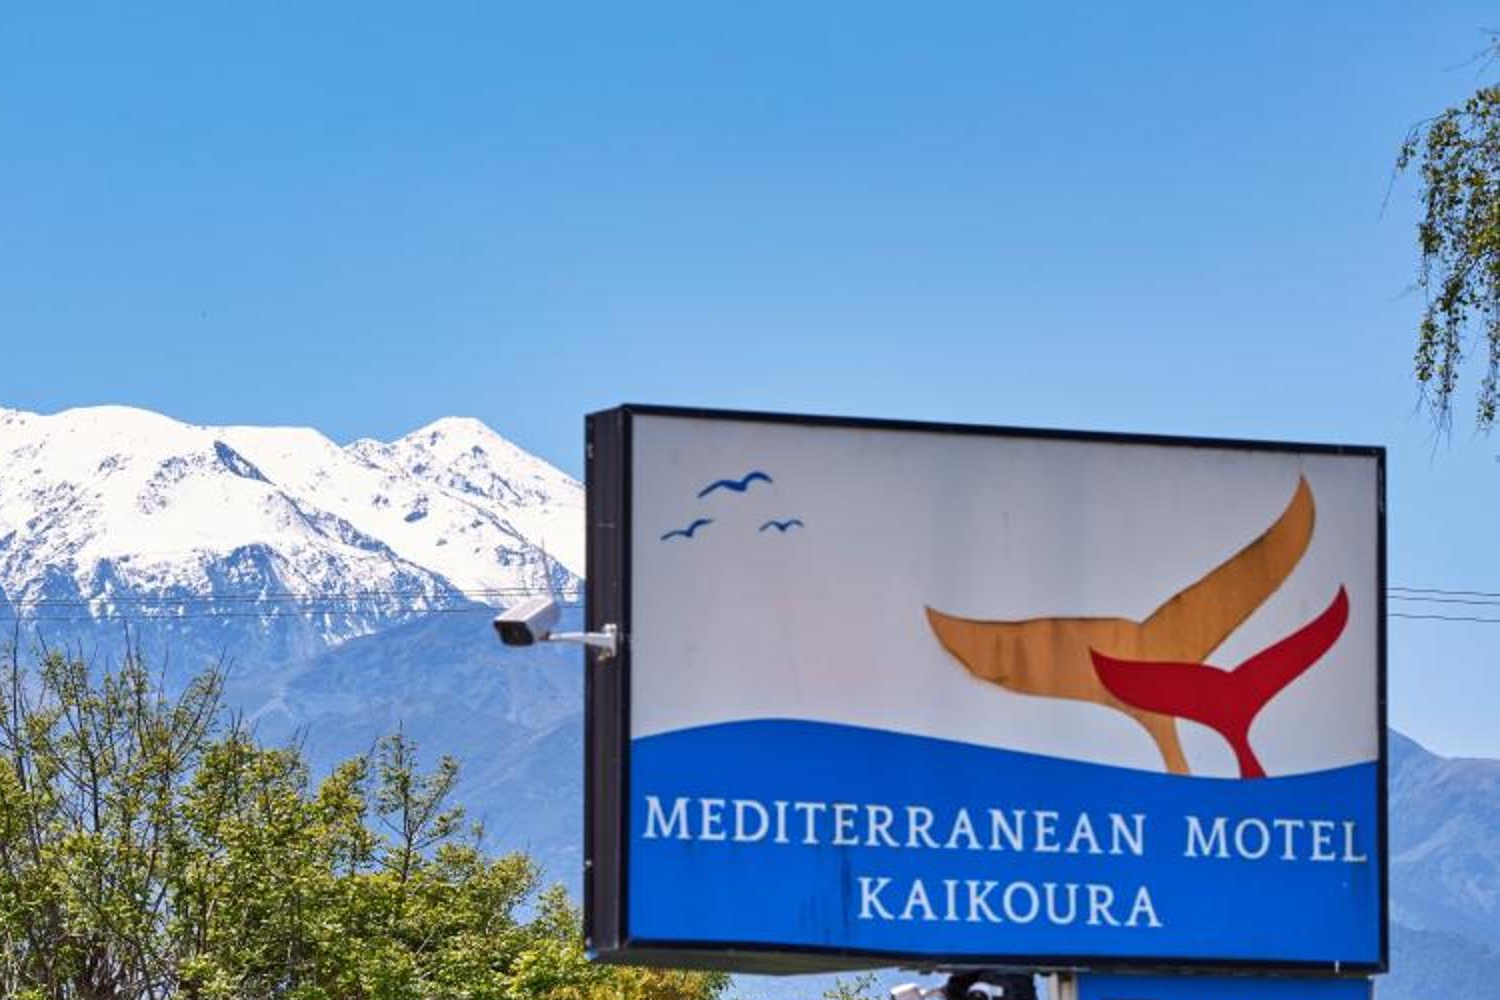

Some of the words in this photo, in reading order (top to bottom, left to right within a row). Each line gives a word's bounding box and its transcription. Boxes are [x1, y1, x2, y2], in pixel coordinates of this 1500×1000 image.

[643, 795, 1145, 856] MEDITERRANEAN
[1185, 815, 1367, 862] MOTEL
[858, 876, 1163, 928] KAIKOURA
